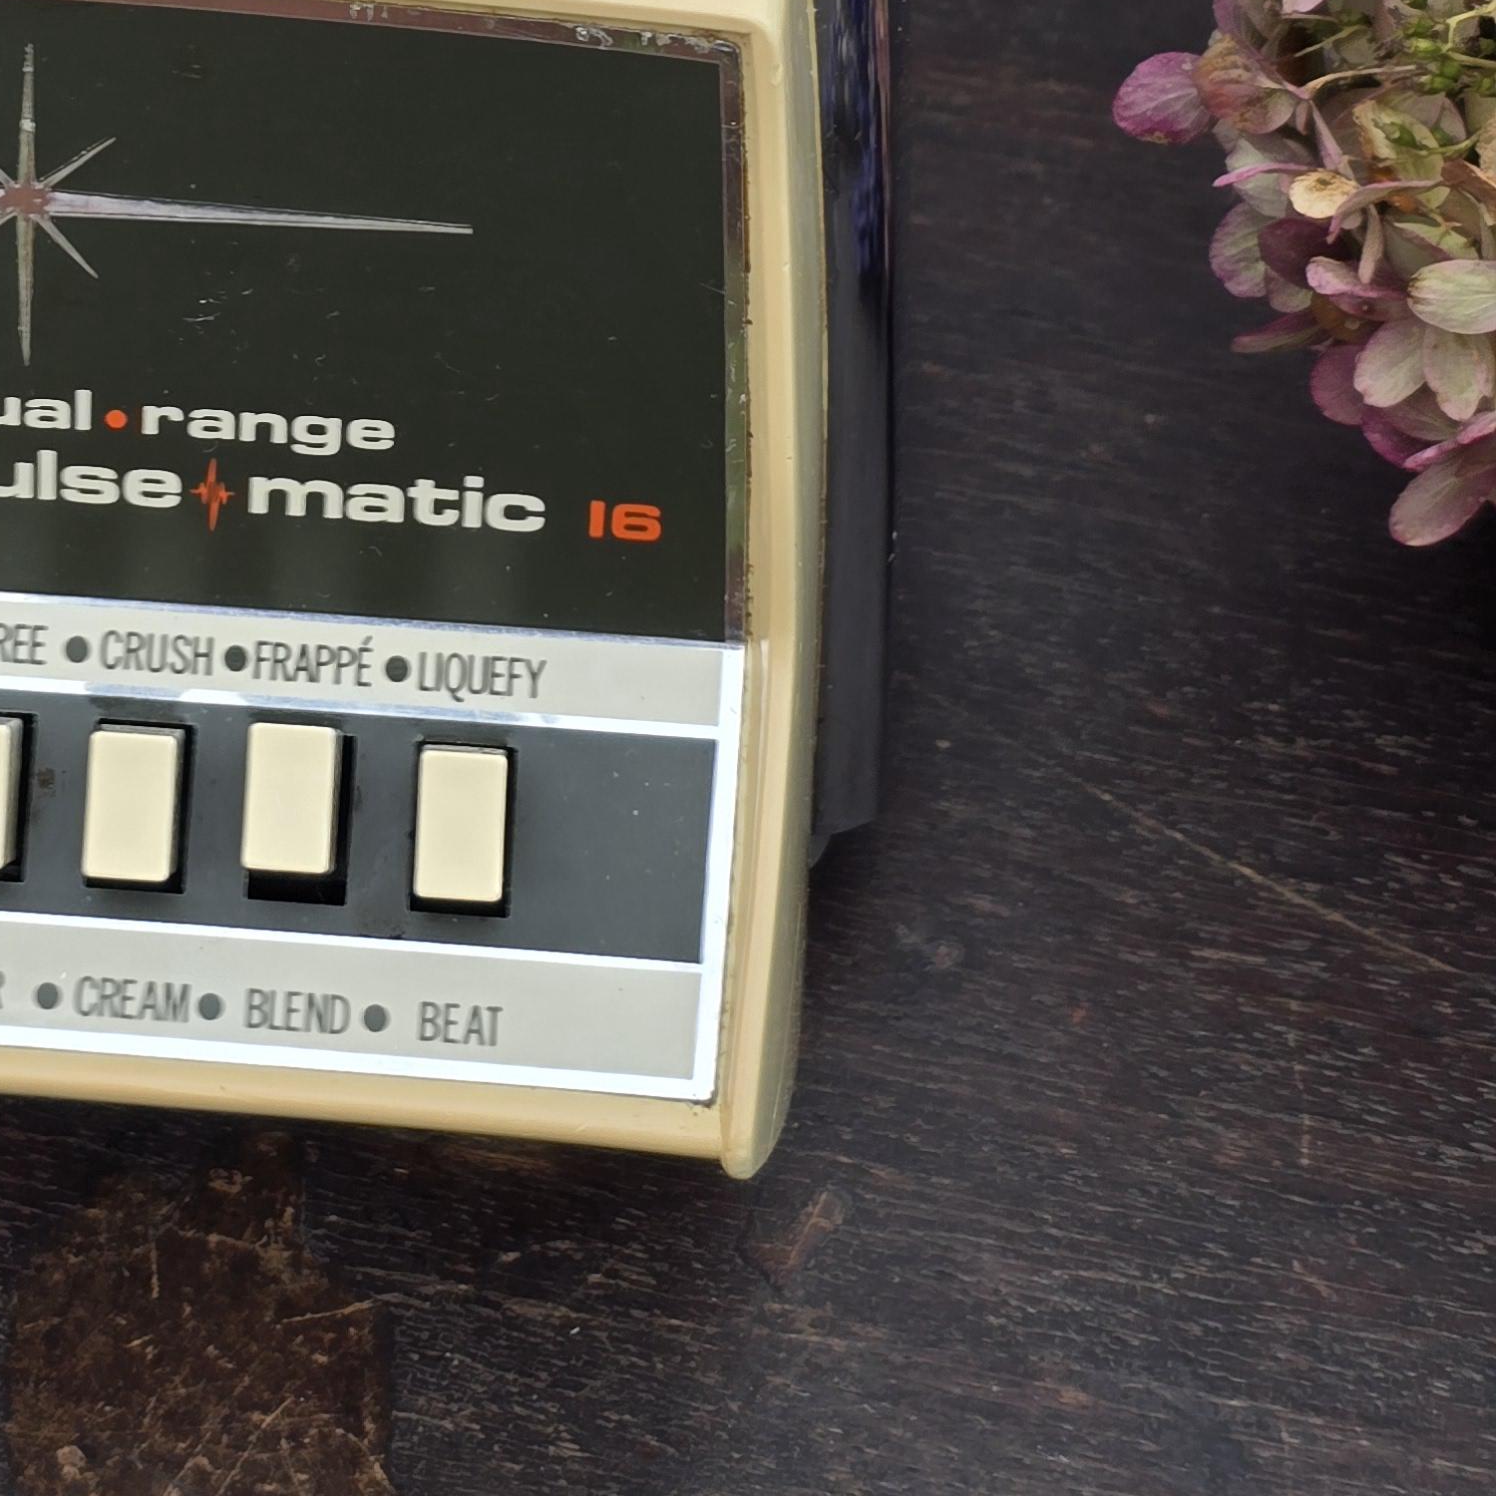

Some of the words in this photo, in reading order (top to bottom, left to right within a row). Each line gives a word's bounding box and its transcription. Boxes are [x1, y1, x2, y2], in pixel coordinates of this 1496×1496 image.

[140, 401, 396, 456] range
[246, 475, 546, 533] matic
[587, 500, 663, 541] 16
[103, 629, 215, 677] CRUSH
[252, 636, 372, 687] FRAPPÉ
[418, 652, 547, 702] LIQUEFY
[73, 976, 192, 1023] CREAM
[244, 988, 351, 1035] BLEND
[417, 1001, 504, 1047] BEAT
